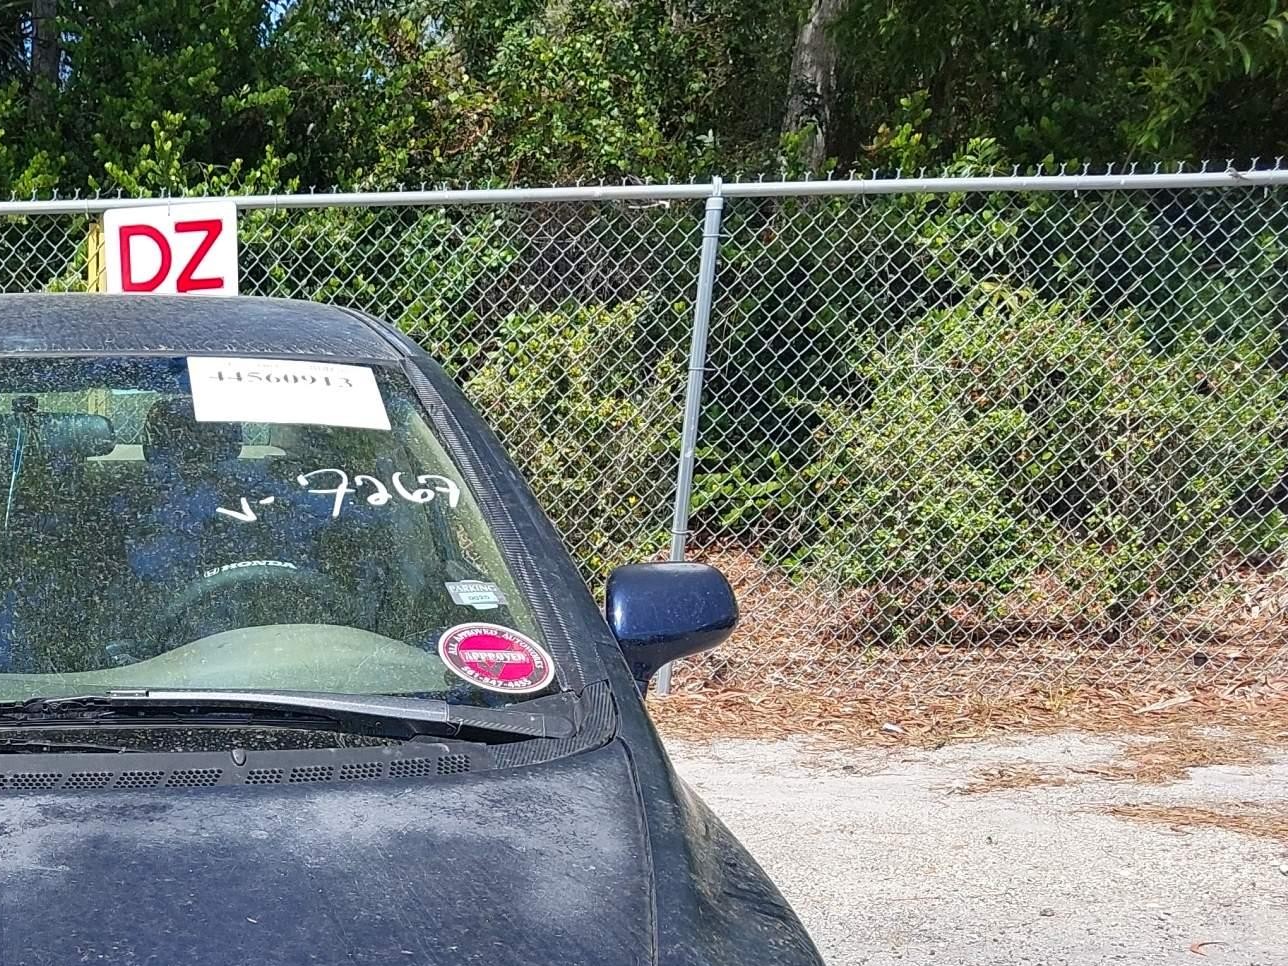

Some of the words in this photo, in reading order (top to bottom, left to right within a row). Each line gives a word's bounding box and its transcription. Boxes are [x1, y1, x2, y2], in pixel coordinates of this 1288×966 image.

[119, 219, 224, 293] DZ
[221, 560, 298, 572] HONDA
[449, 584, 498, 592] PARKING
[464, 651, 527, 662] APPROVED
